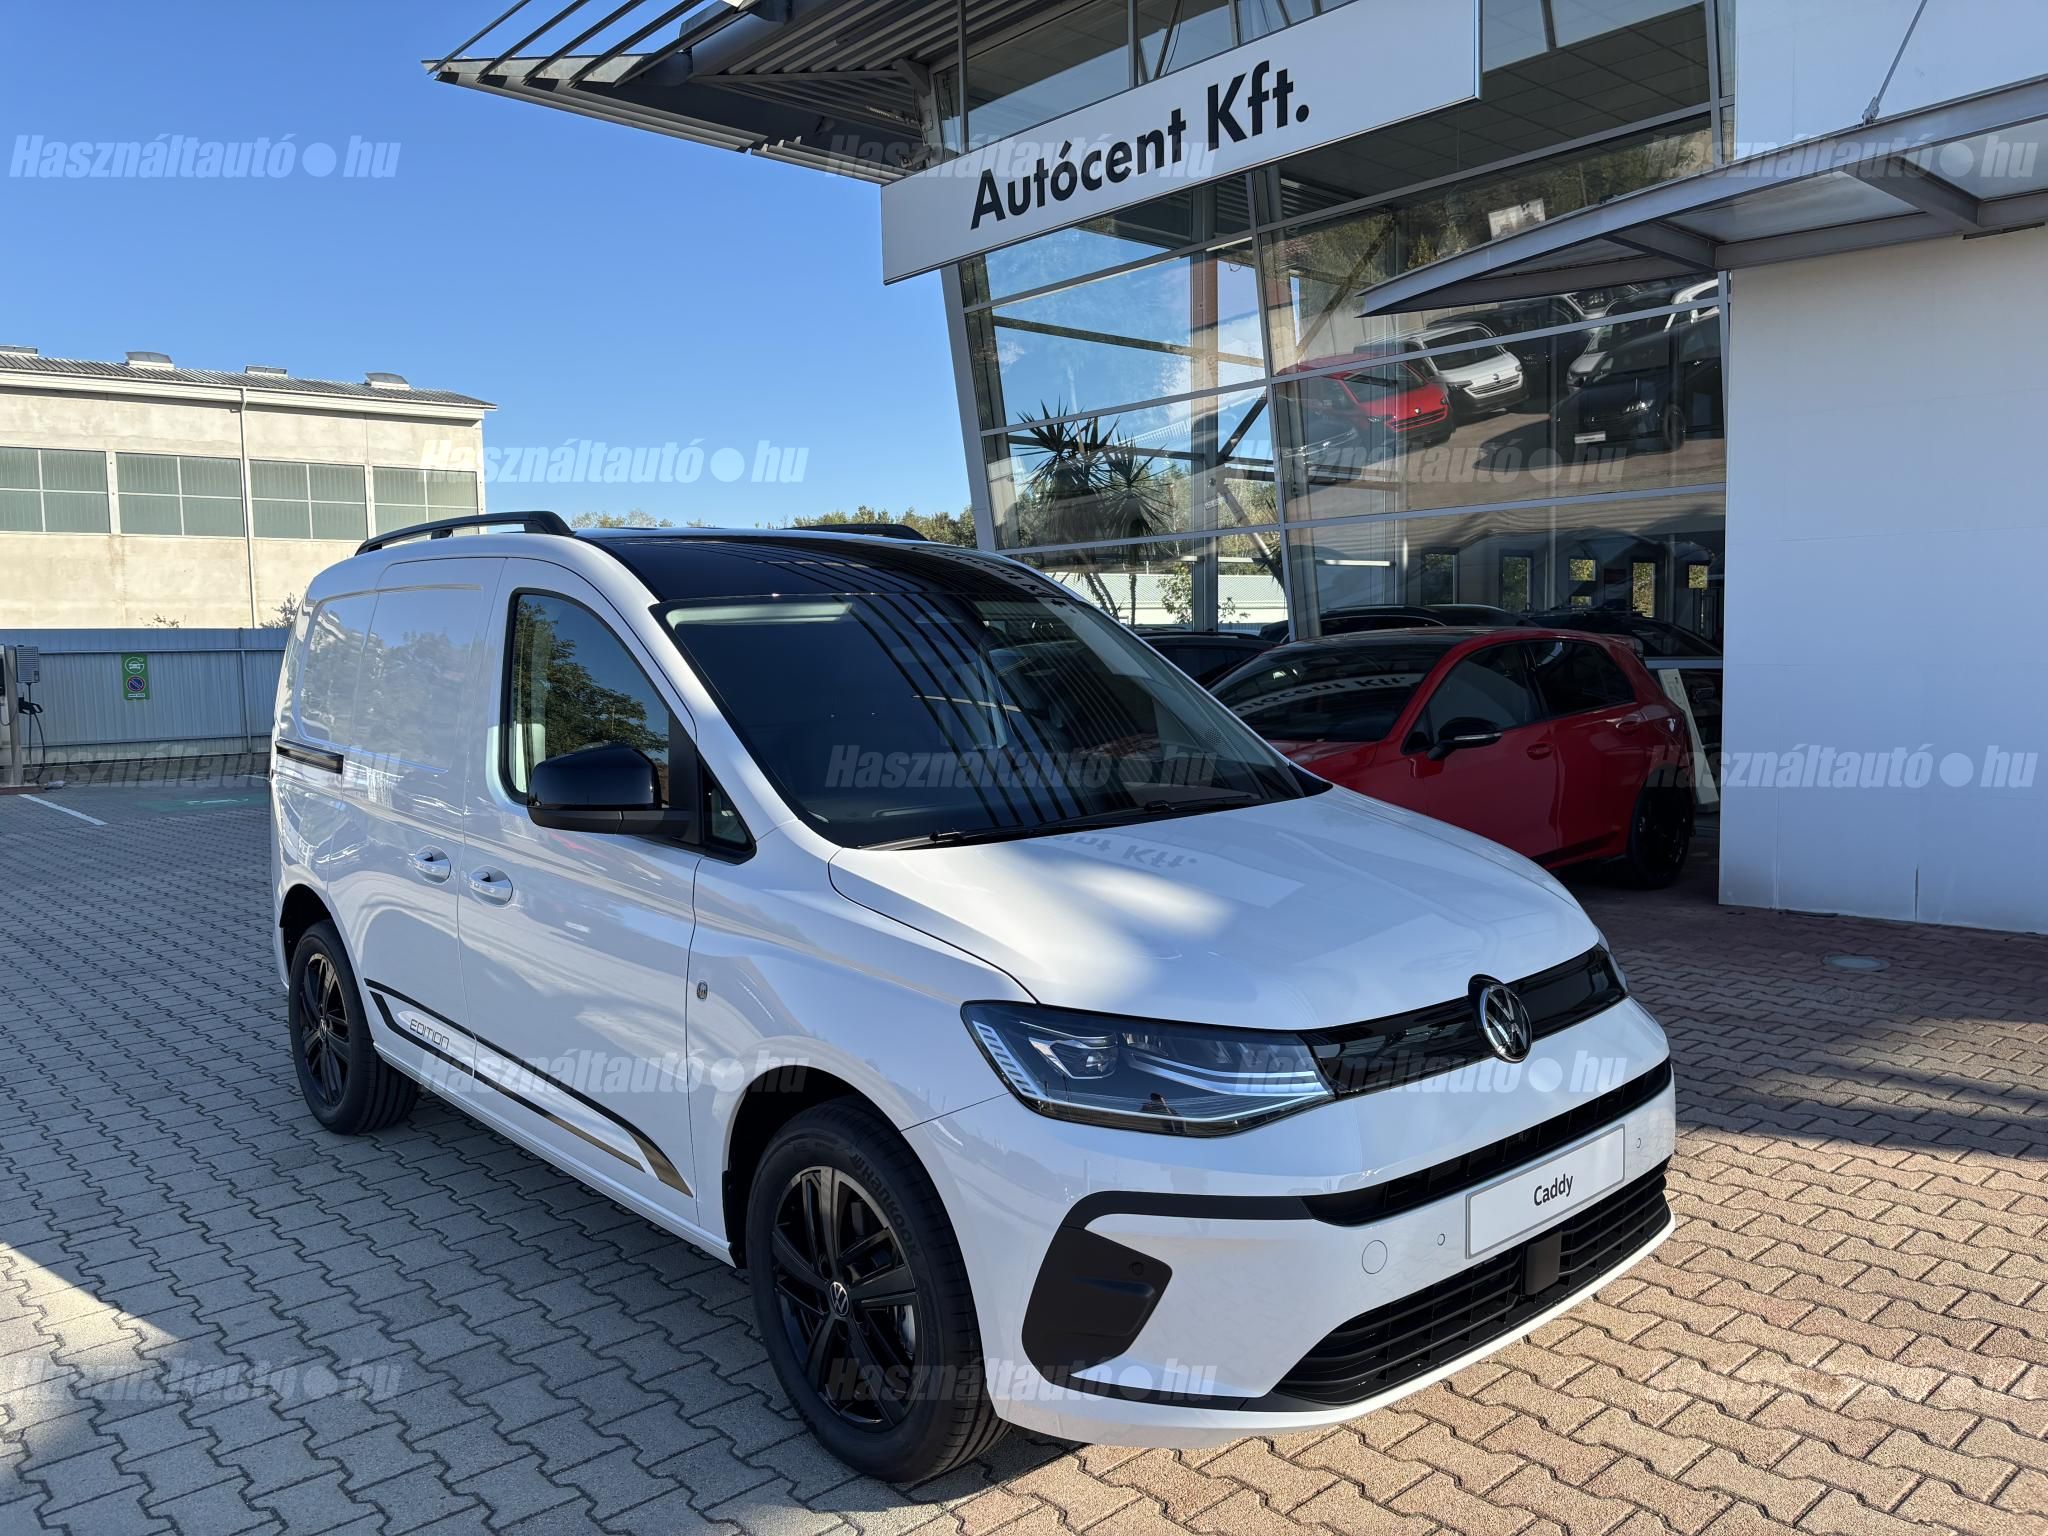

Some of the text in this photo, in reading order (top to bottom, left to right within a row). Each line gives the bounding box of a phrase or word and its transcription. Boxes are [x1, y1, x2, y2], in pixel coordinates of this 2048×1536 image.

[971, 60, 1310, 230] Autócent Kft.
[1534, 1173, 1573, 1206] Caddy
